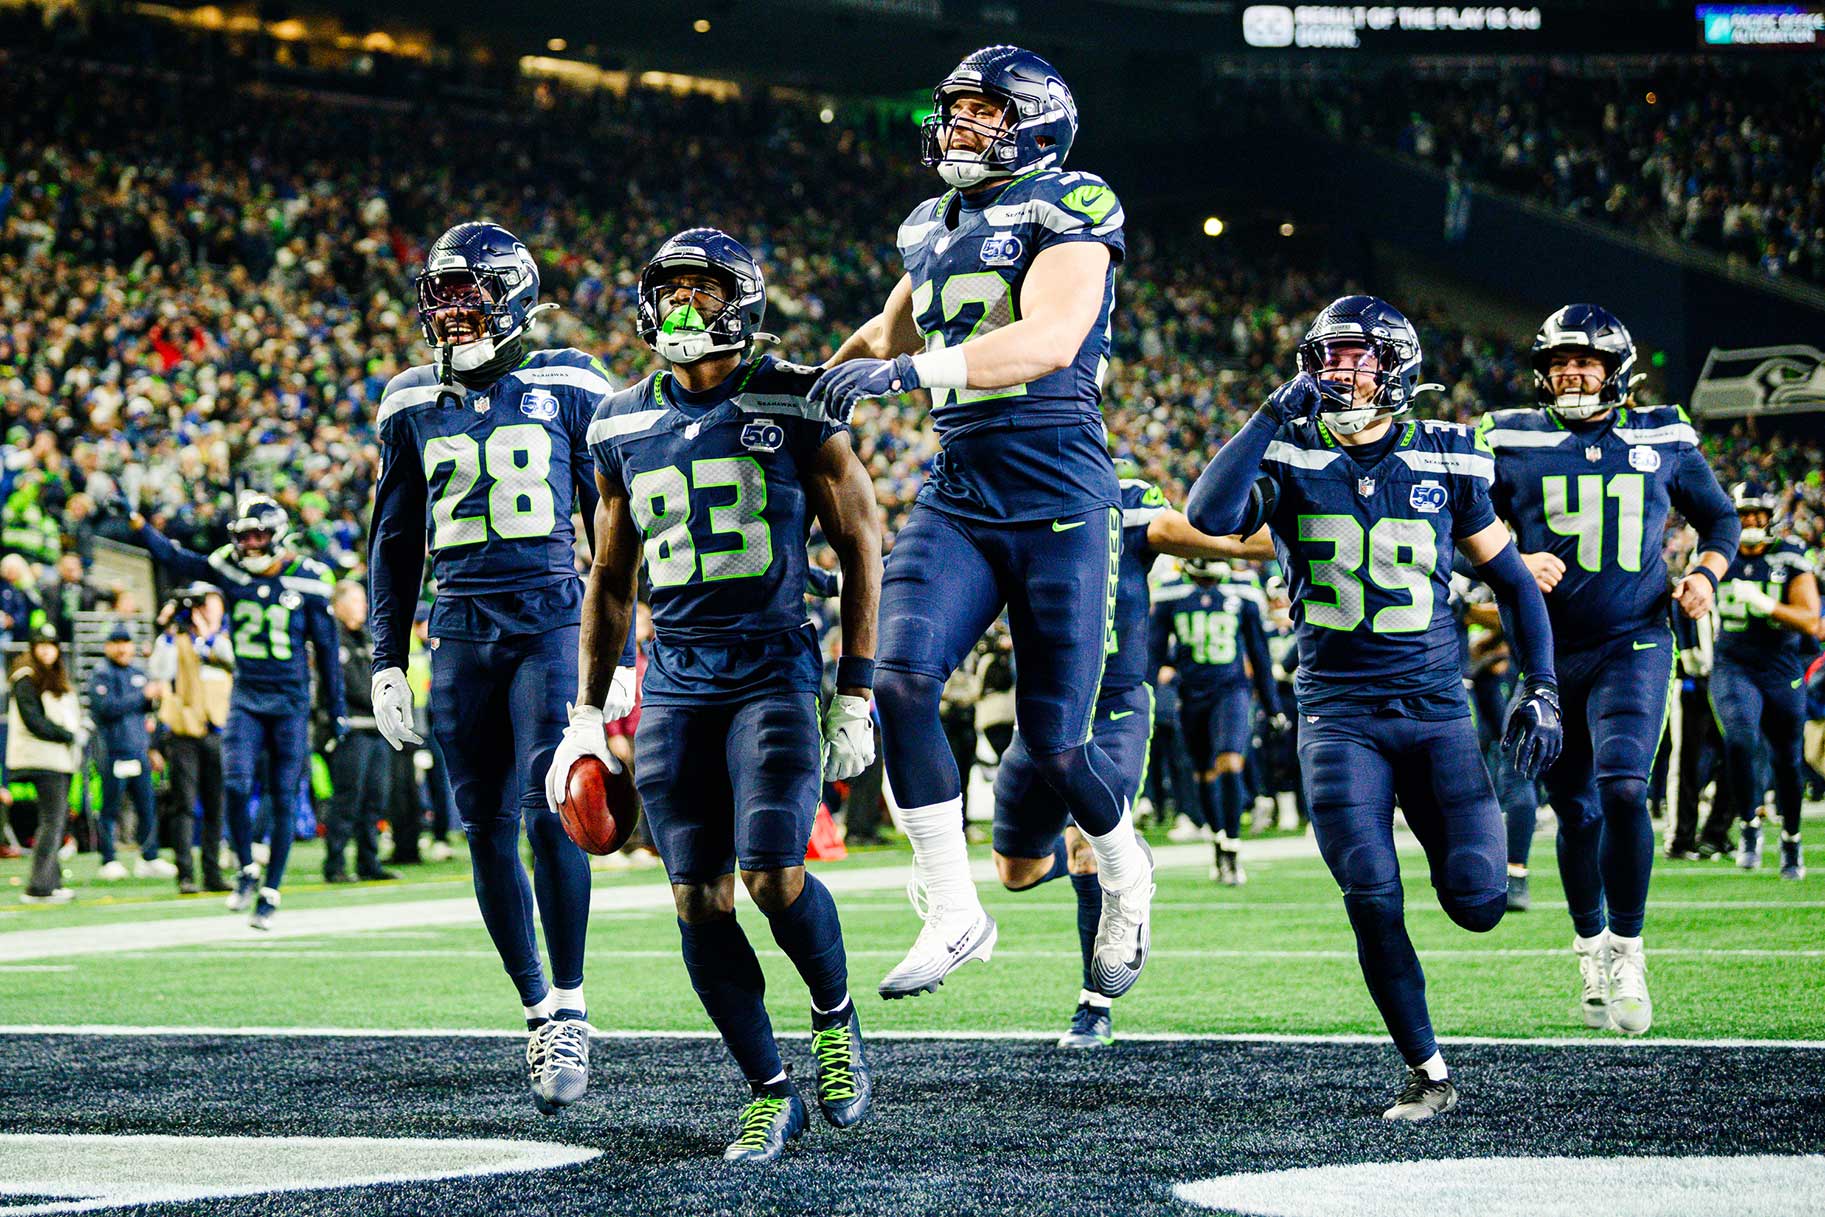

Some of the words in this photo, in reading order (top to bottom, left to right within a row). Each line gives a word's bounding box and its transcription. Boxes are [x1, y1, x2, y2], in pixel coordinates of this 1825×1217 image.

[1397, 7, 1436, 30] THE
[1436, 7, 1485, 30] PLAY
[521, 391, 559, 419] 50
[757, 400, 798, 408] SEAHAWKS
[741, 423, 784, 450] 50
[424, 424, 556, 550] 28
[1411, 484, 1448, 509] 50
[631, 456, 774, 588] 83
[1542, 473, 1644, 573] 41
[1298, 514, 1438, 633] 39
[233, 598, 292, 660] 21
[1174, 610, 1239, 665] 48
